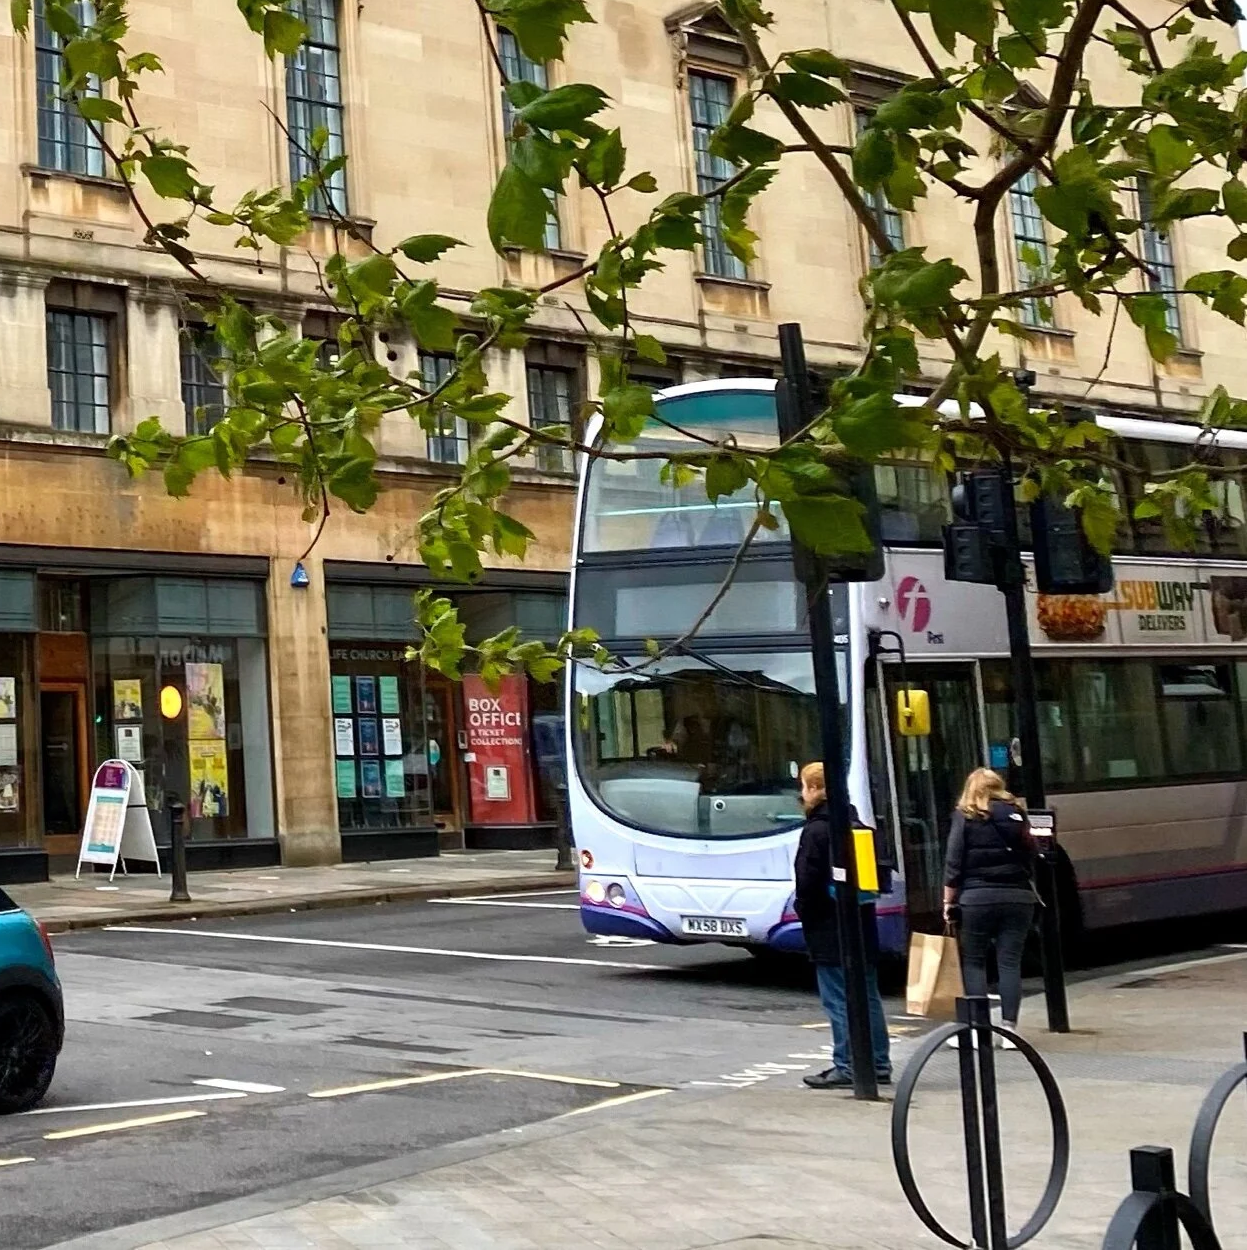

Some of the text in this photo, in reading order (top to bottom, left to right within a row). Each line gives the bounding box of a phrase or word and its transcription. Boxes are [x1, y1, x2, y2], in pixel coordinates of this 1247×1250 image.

[1119, 580, 1197, 611] SUBWAY
[1138, 614, 1186, 631] DELIVERS
[350, 648, 390, 661] CHURCH
[468, 698, 502, 712] BOX
[478, 729, 505, 737] TICKET
[687, 918, 743, 935] MX58 DXS
